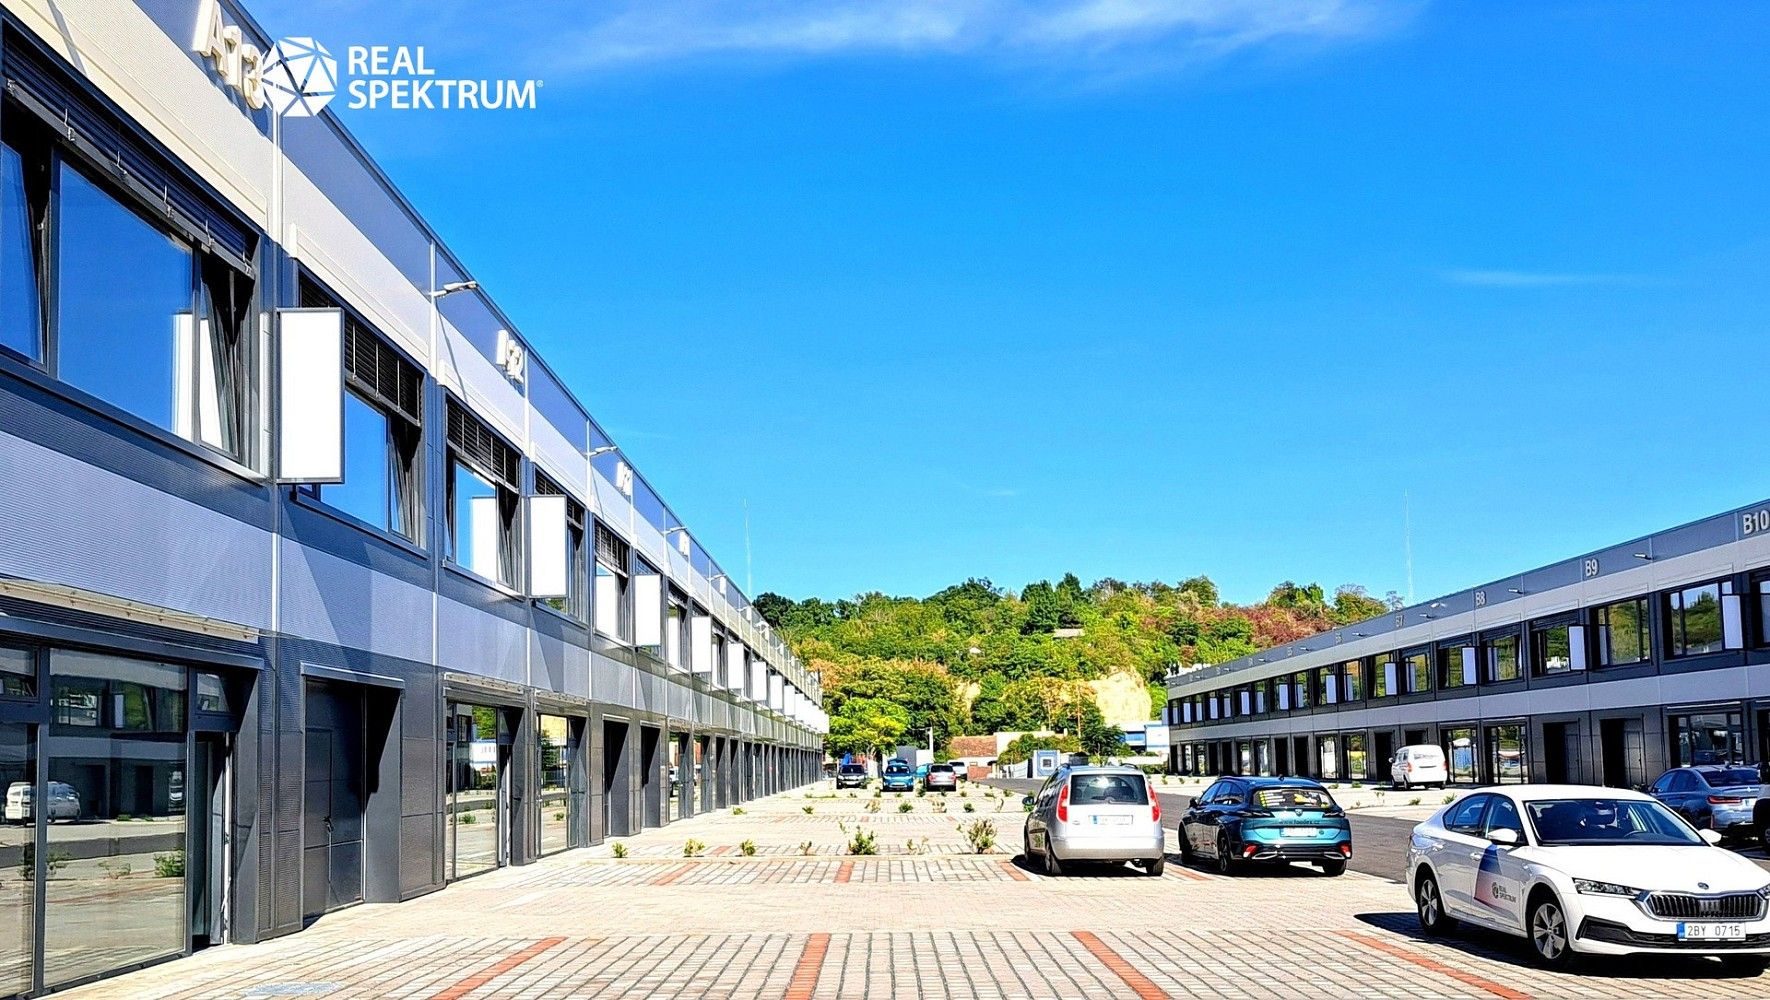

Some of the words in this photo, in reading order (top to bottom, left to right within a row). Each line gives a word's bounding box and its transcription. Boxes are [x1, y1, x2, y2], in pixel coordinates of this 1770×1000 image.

[1742, 509, 1770, 535] B10
[1584, 558, 1599, 577] B9
[1475, 590, 1487, 606] B8
[1687, 925, 1707, 937] 2BY
[1714, 925, 1741, 937] 0715
